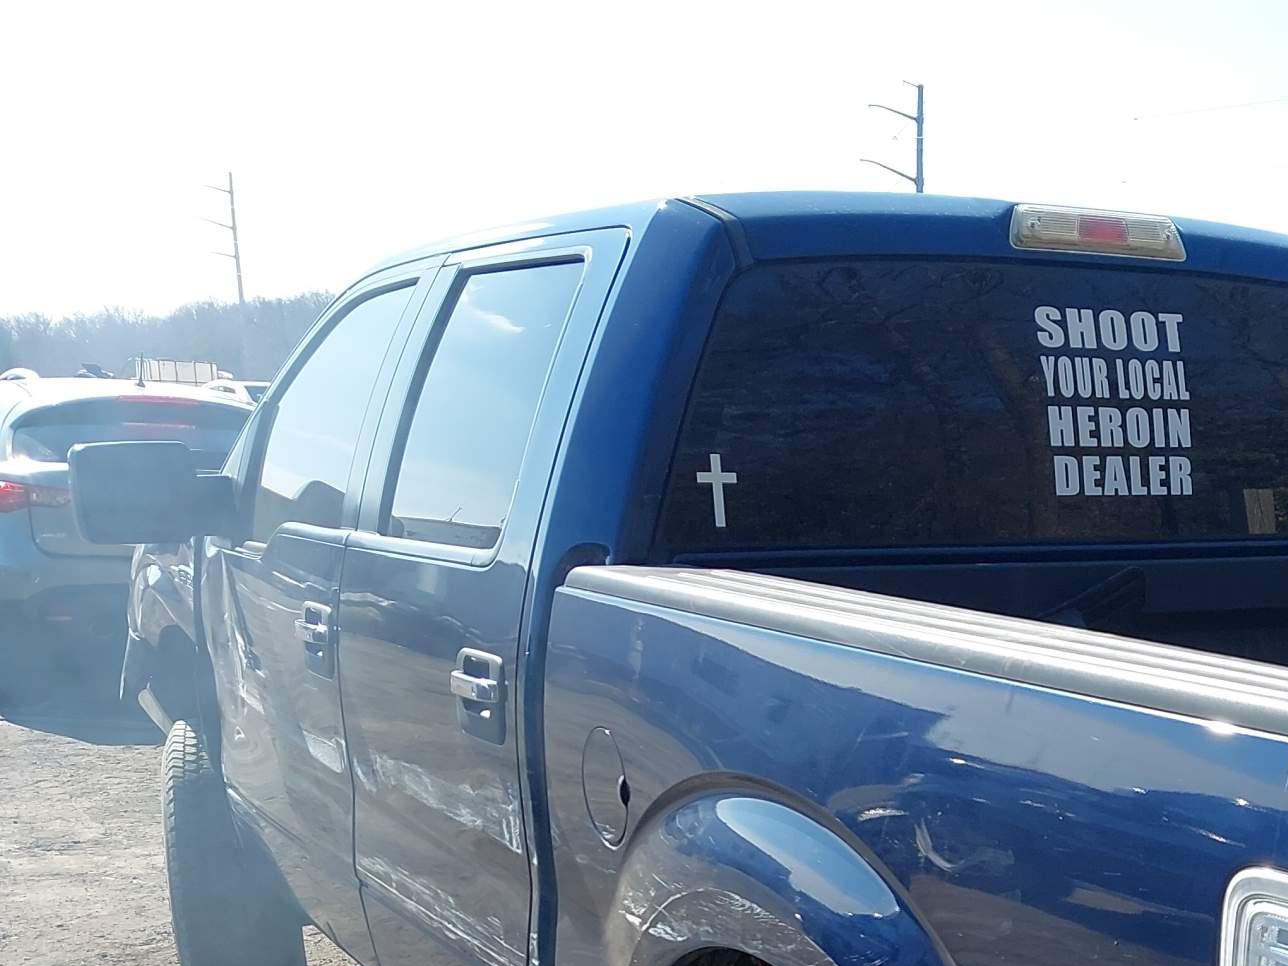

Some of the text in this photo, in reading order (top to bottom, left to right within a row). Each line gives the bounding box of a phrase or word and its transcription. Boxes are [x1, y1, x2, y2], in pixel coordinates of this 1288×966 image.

[1034, 306, 1183, 352] SHOOT
[1040, 355, 1190, 400] YOUR LOCAL
[1047, 405, 1192, 448] HEROIN
[1053, 455, 1193, 496] DEALER
